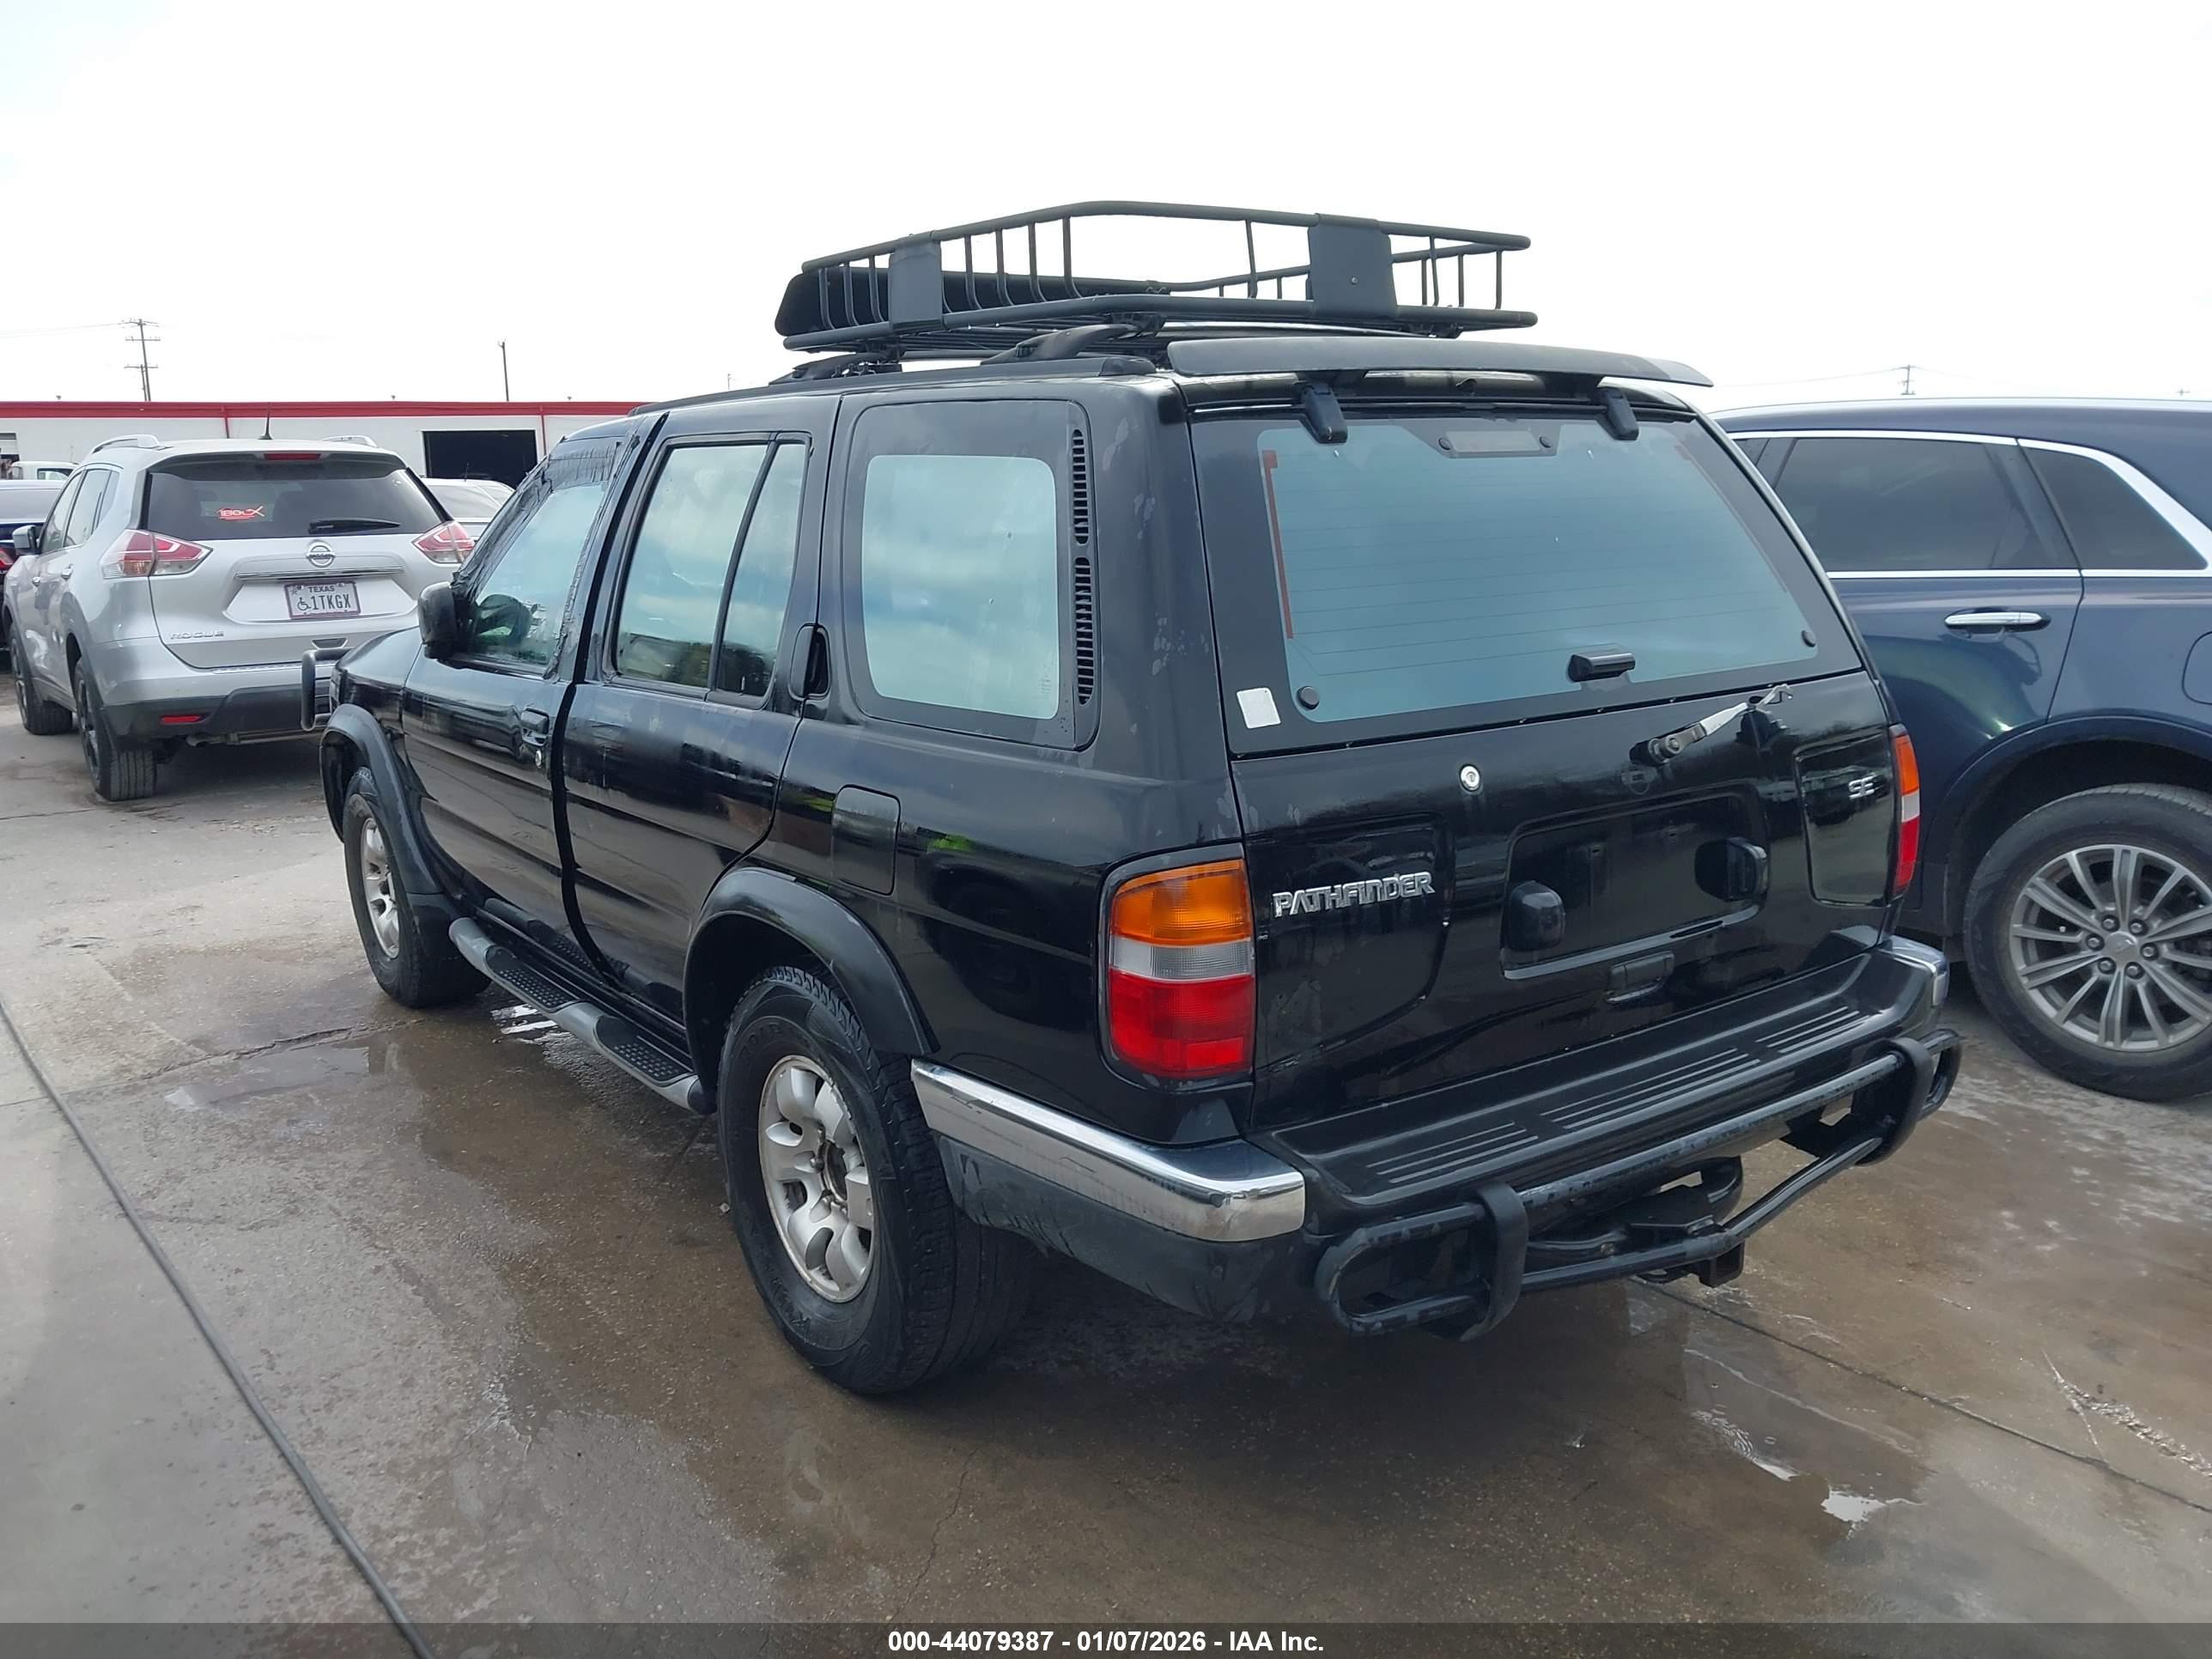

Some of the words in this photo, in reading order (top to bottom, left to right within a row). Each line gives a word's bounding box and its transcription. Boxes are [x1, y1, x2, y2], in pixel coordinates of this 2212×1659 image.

[308, 585, 336, 593] TEXAS
[310, 593, 351, 611] 1TKGX
[170, 630, 225, 641] ROGUE
[1847, 771, 1877, 800] SE
[1272, 871, 1437, 918] PATHFINDER
